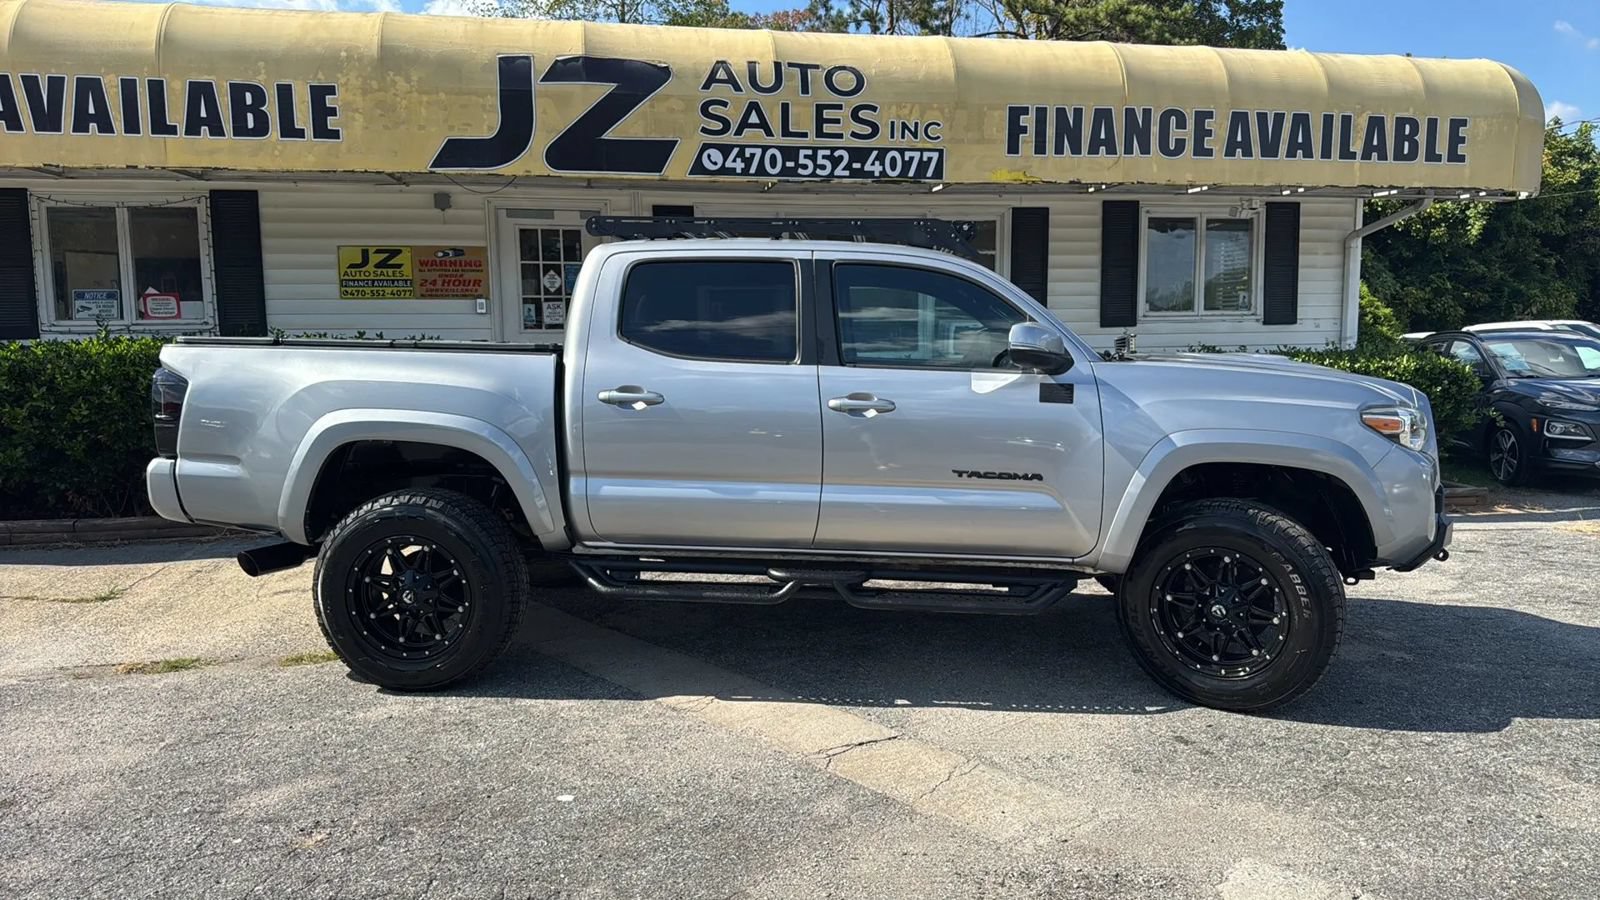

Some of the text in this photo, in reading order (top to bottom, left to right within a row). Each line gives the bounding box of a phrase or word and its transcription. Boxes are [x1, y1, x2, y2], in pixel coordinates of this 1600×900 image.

[700, 59, 866, 97] AUTO
[428, 54, 681, 175] JZ
[700, 98, 881, 142] SALES
[889, 119, 944, 142] INC
[1006, 104, 1215, 159] FINANCE
[1223, 109, 1470, 164] AVAILABLE
[724, 148, 940, 179] 470-552-4077
[346, 248, 404, 269] JZ
[418, 259, 482, 268] WARNING
[342, 270, 371, 278] AUTO
[372, 270, 404, 278] SALES
[419, 279, 482, 288] 24 HOUR
[84, 291, 107, 300] NOTICE
[349, 289, 413, 297] 470-552-4077
[546, 303, 562, 311] ASK
[952, 469, 1044, 481] TACOMA
